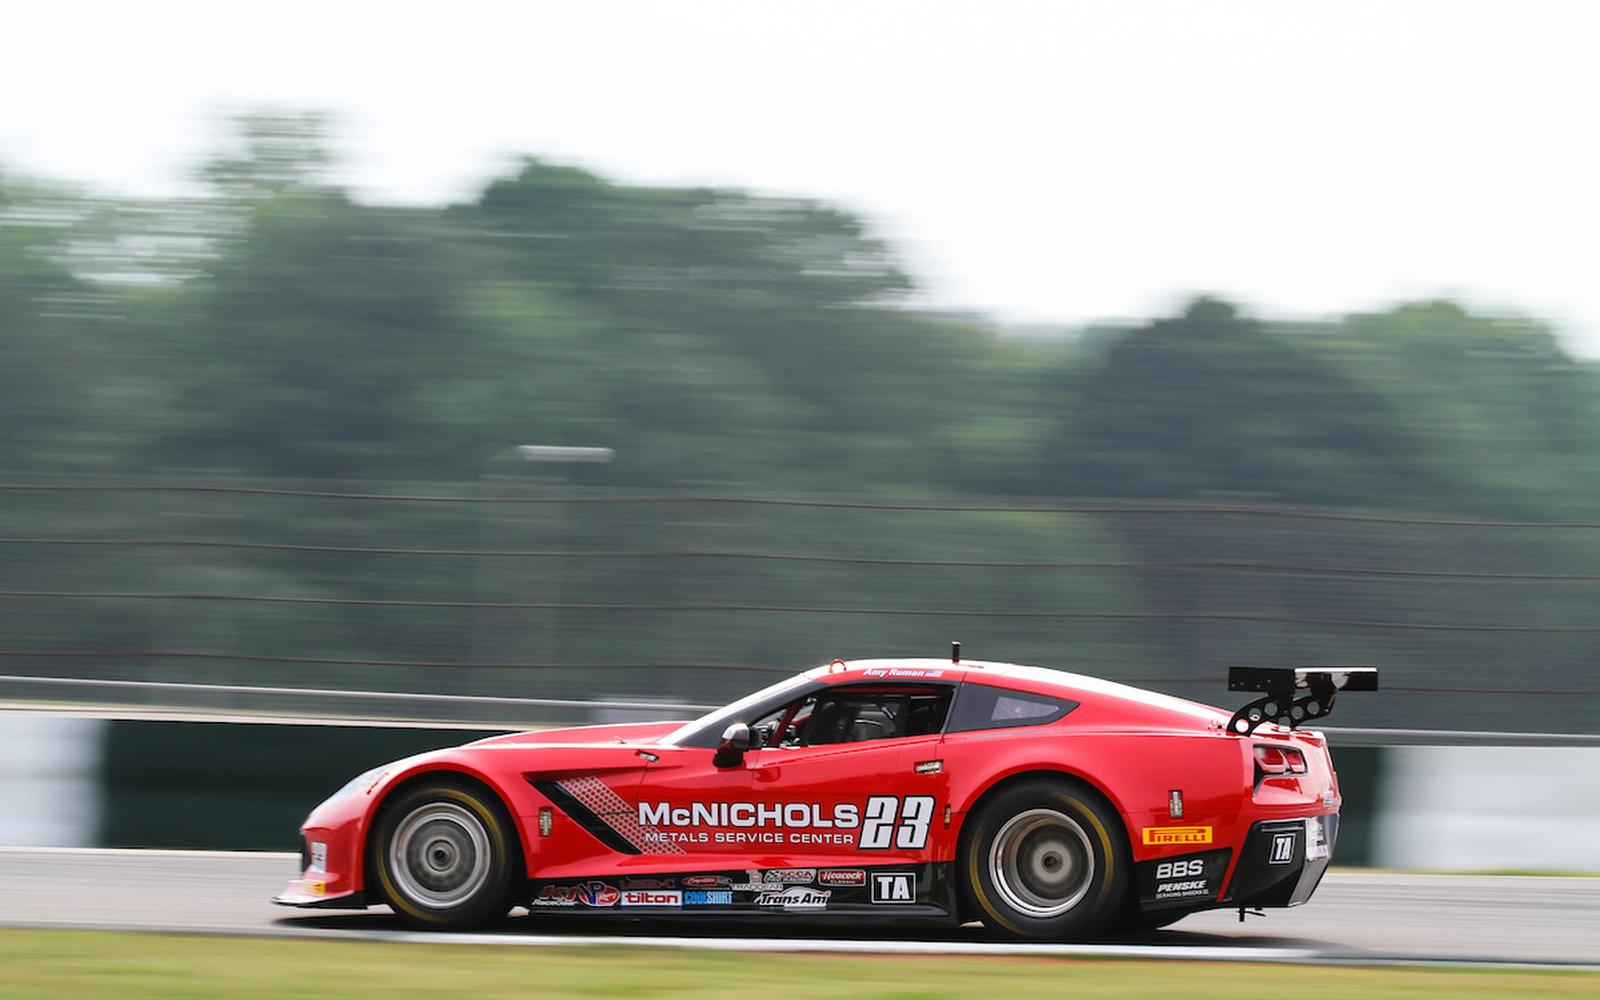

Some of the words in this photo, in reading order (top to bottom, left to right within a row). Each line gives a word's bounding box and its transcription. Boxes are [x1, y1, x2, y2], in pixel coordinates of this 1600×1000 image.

[863, 668, 887, 677] Amy
[889, 668, 924, 677] Ruman
[637, 802, 859, 828] McNICHOLS
[859, 795, 934, 850] 23
[645, 832, 708, 843] METALS
[714, 833, 783, 843] SERVICE
[789, 833, 854, 844] CENTER
[1149, 828, 1206, 842] PIRELLI
[1275, 837, 1292, 861] TA
[1156, 860, 1204, 879] BBS
[877, 876, 910, 900] TA
[1157, 880, 1207, 892] PENSKE
[624, 892, 678, 904] tilton
[760, 893, 800, 905] Trans
[801, 893, 829, 904] Am
